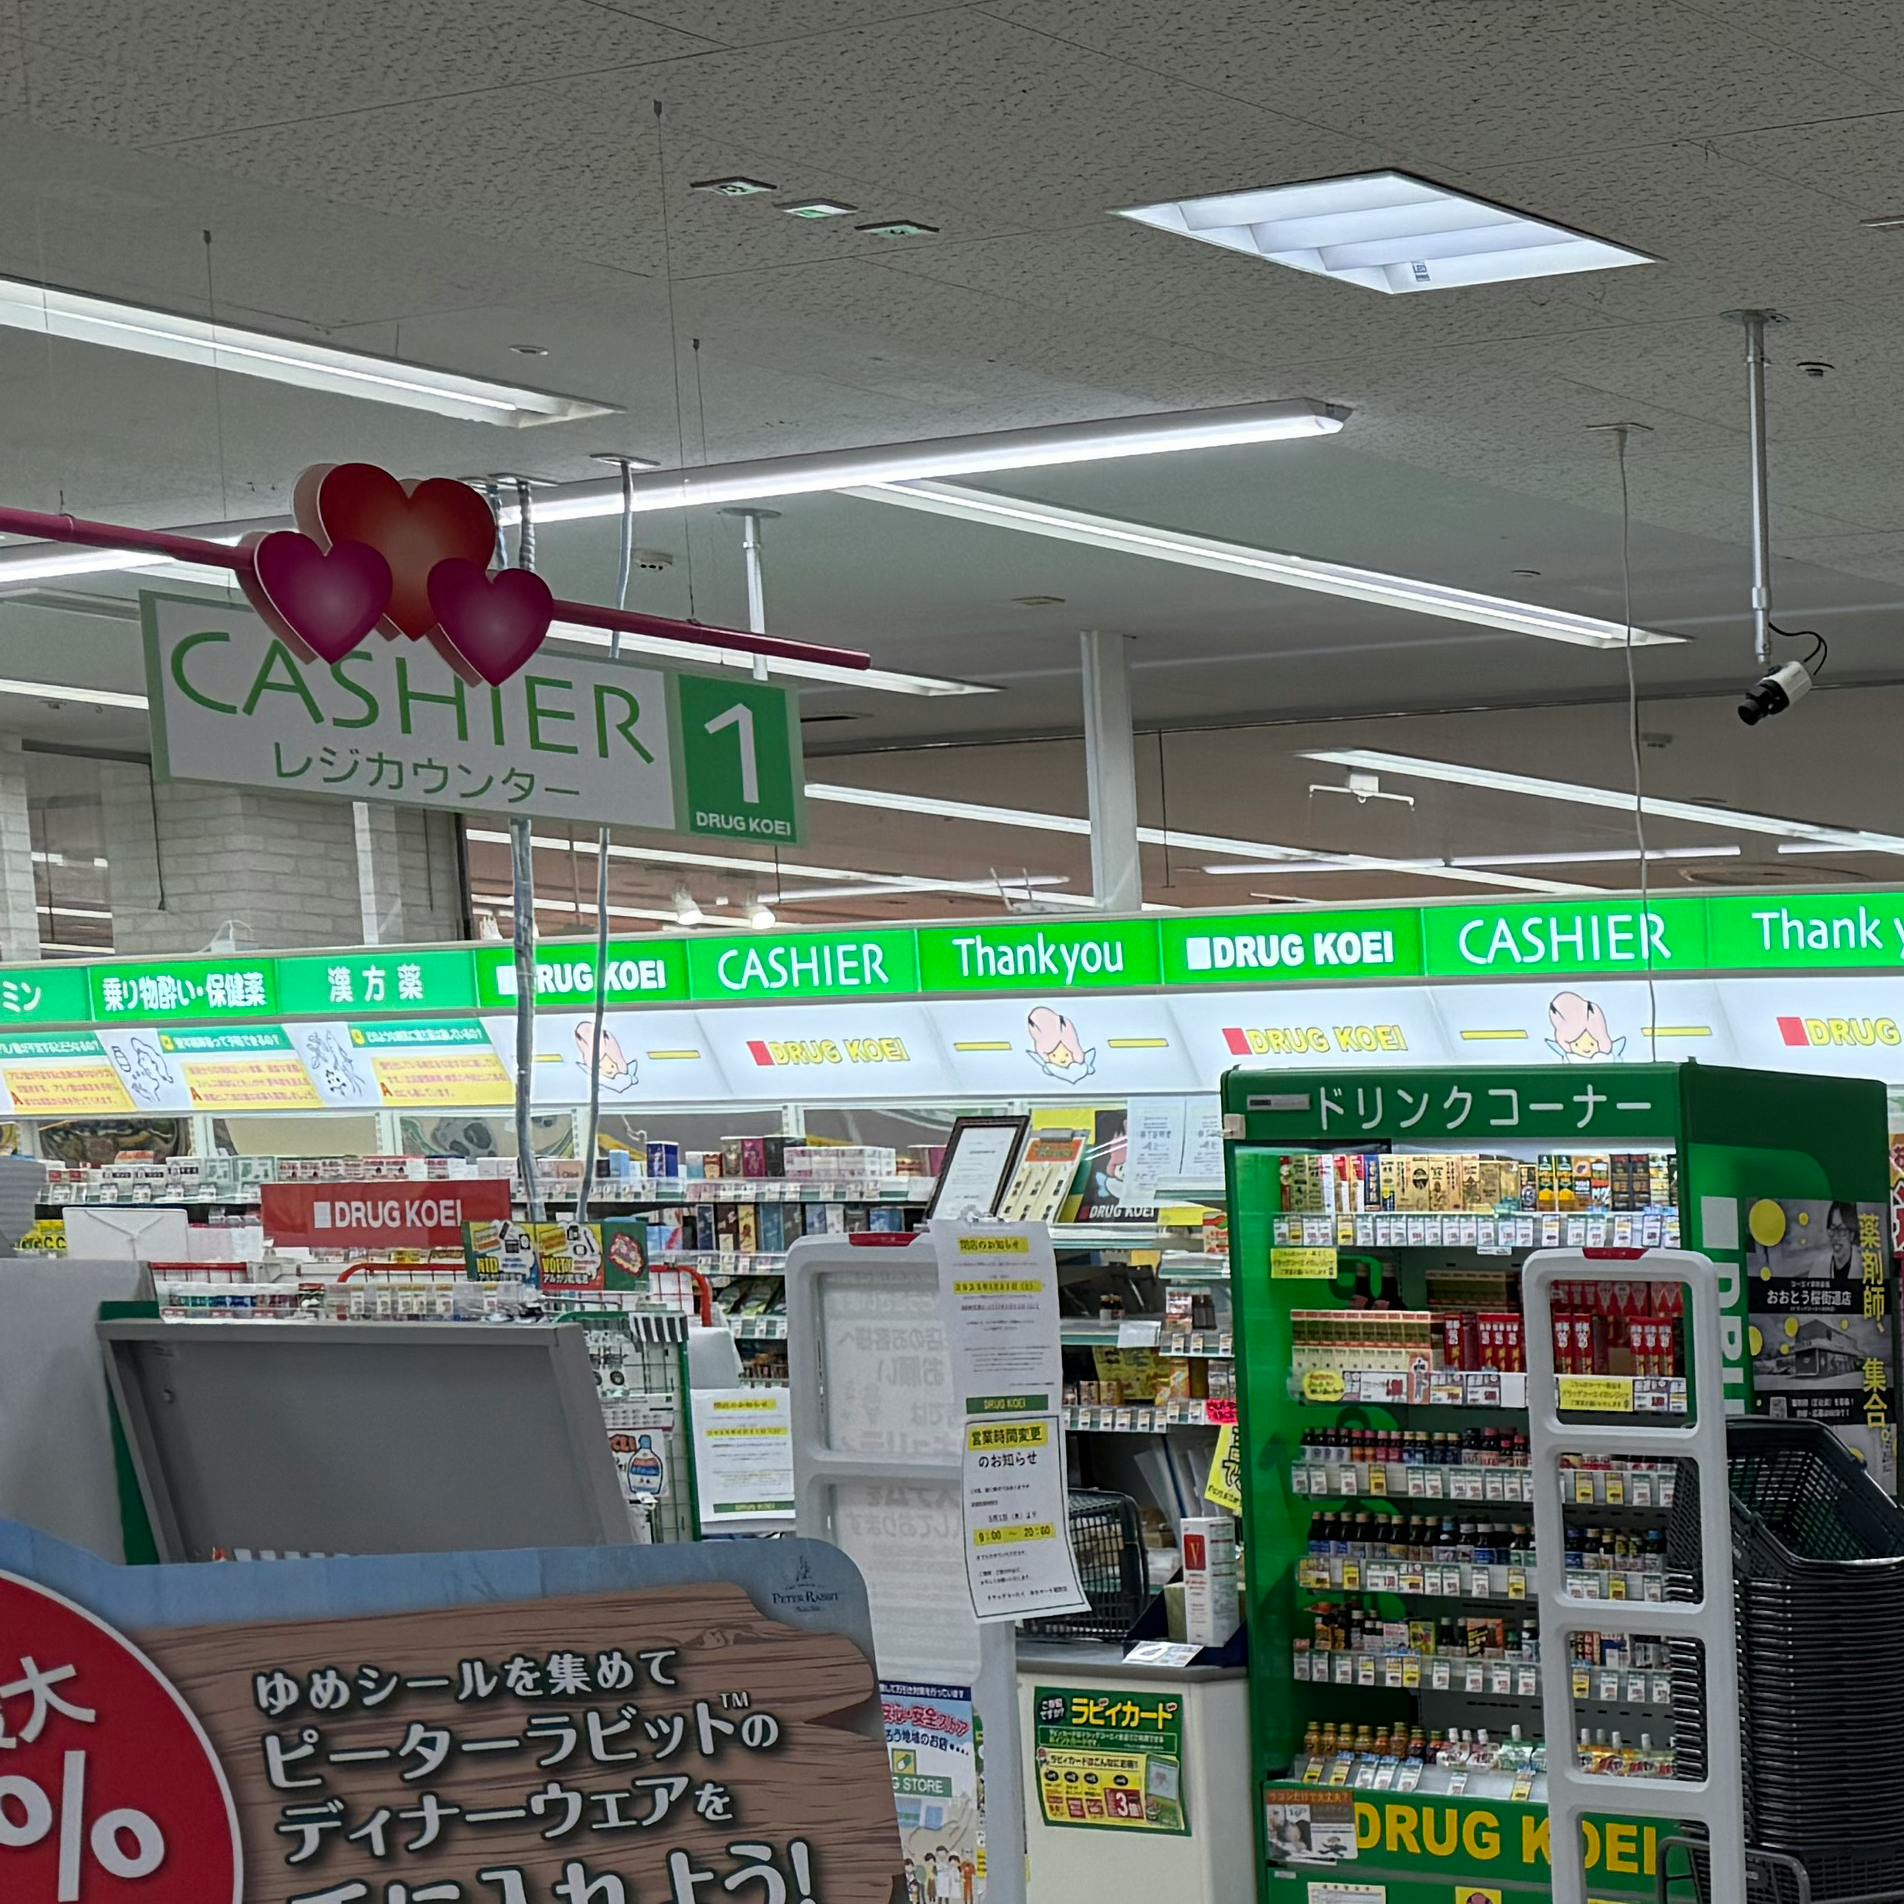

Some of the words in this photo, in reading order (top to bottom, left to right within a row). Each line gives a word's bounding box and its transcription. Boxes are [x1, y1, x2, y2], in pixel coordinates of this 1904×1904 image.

[170, 631, 656, 765] CASHIER
[704, 701, 761, 805] 1
[272, 741, 581, 805] レジカウンター
[696, 810, 750, 834] DRUG
[753, 816, 792, 836] KOEI
[1212, 933, 1304, 969] DRUG
[1316, 930, 1394, 966] KOEI
[1459, 912, 1672, 966] CASHIER
[1752, 907, 1884, 953] Thank
[328, 964, 424, 1004] 漢方薬
[605, 958, 667, 991] KOEI
[717, 942, 888, 993] CASHIER
[102, 970, 266, 1012] 乗り物酔い・保健薬
[771, 1040, 841, 1066] DRUG
[847, 1036, 910, 1063] KOEI
[1245, 1026, 1331, 1056] DRUG
[1337, 1023, 1409, 1053] KOEI
[1807, 1017, 1902, 1047] DRUG
[1318, 1083, 1653, 1131] ドリンクコーナー
[334, 1201, 400, 1229] DRUG
[405, 1199, 462, 1228] KOEI
[971, 1426, 1042, 1446] 営業時間変更
[978, 1451, 1038, 1468] のお知らせ
[255, 1648, 678, 1718] ゆめシールを集めて
[903, 1777, 944, 1794] STORE
[279, 1775, 735, 1864] ディナーウェアを
[1354, 1802, 1501, 1861] DRUG
